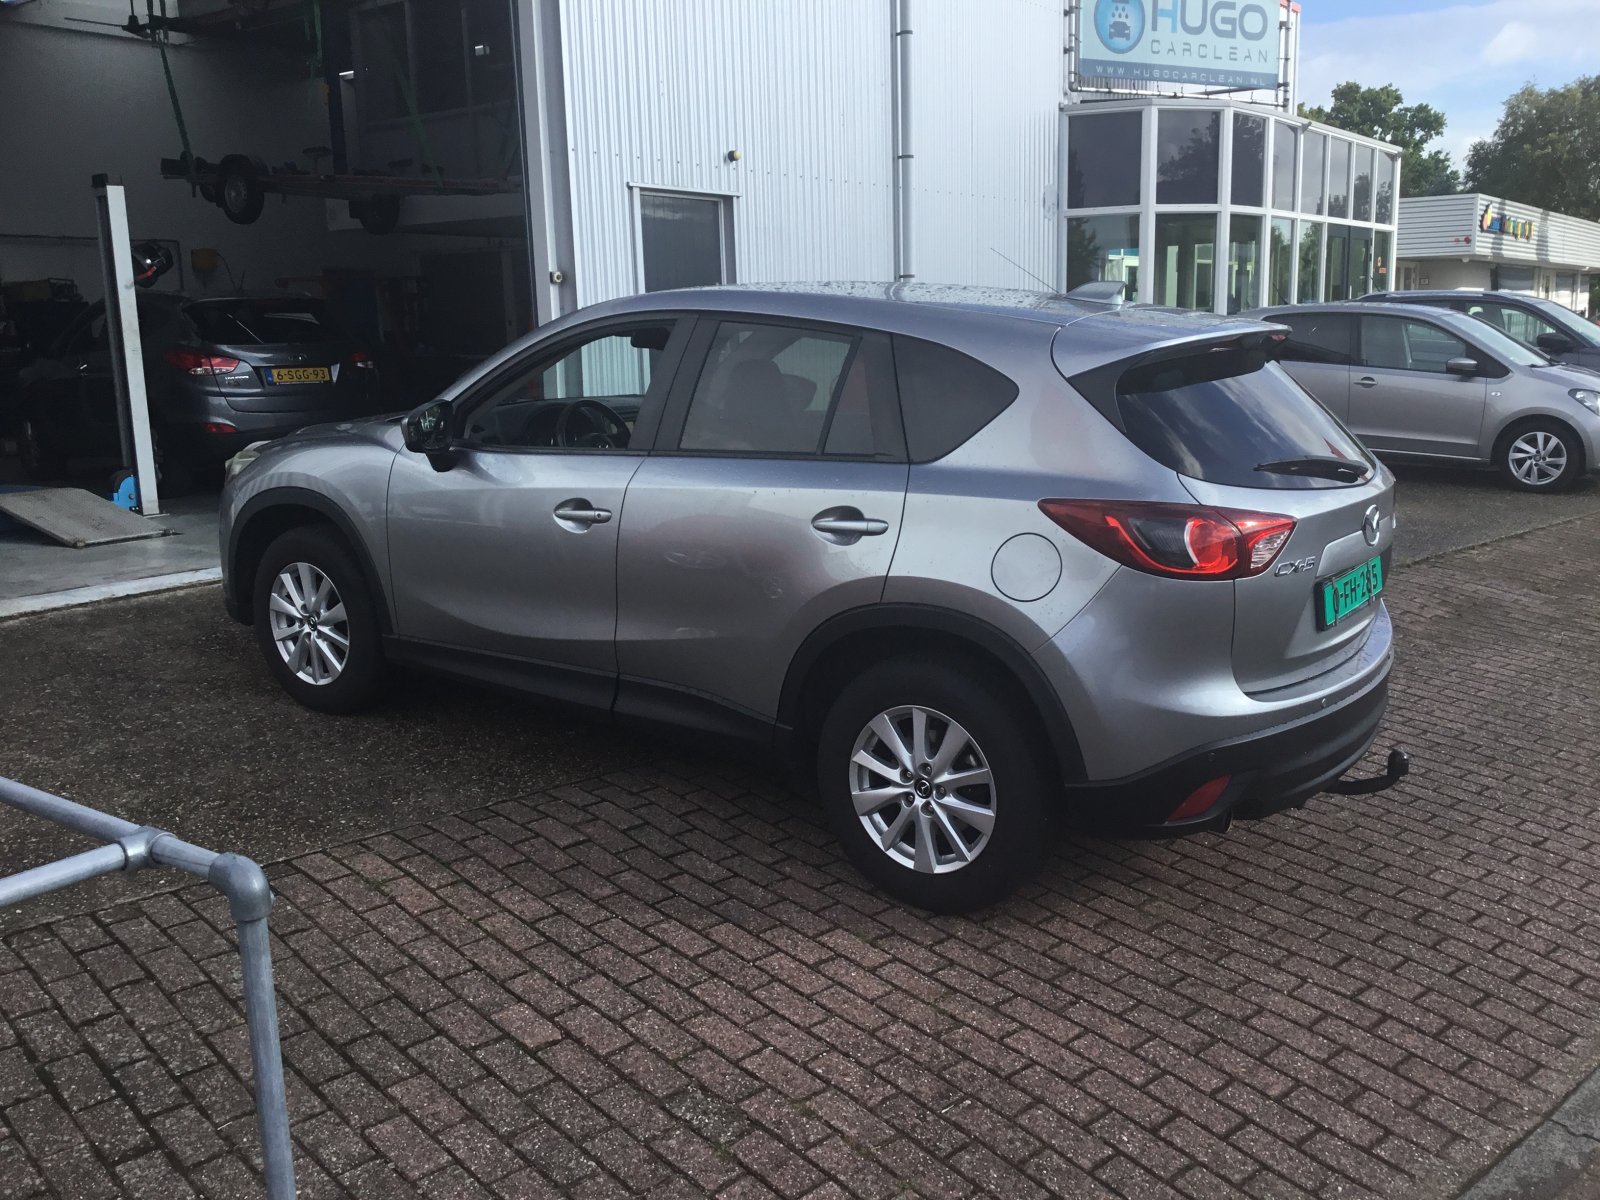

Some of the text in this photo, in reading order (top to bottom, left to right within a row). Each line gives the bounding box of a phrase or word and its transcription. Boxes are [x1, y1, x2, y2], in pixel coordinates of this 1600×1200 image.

[1151, 0, 1268, 41] HUGO
[1150, 40, 1269, 63] CARCLEAN
[276, 367, 326, 381] 6-SGG-93
[1274, 555, 1316, 577] CX-5
